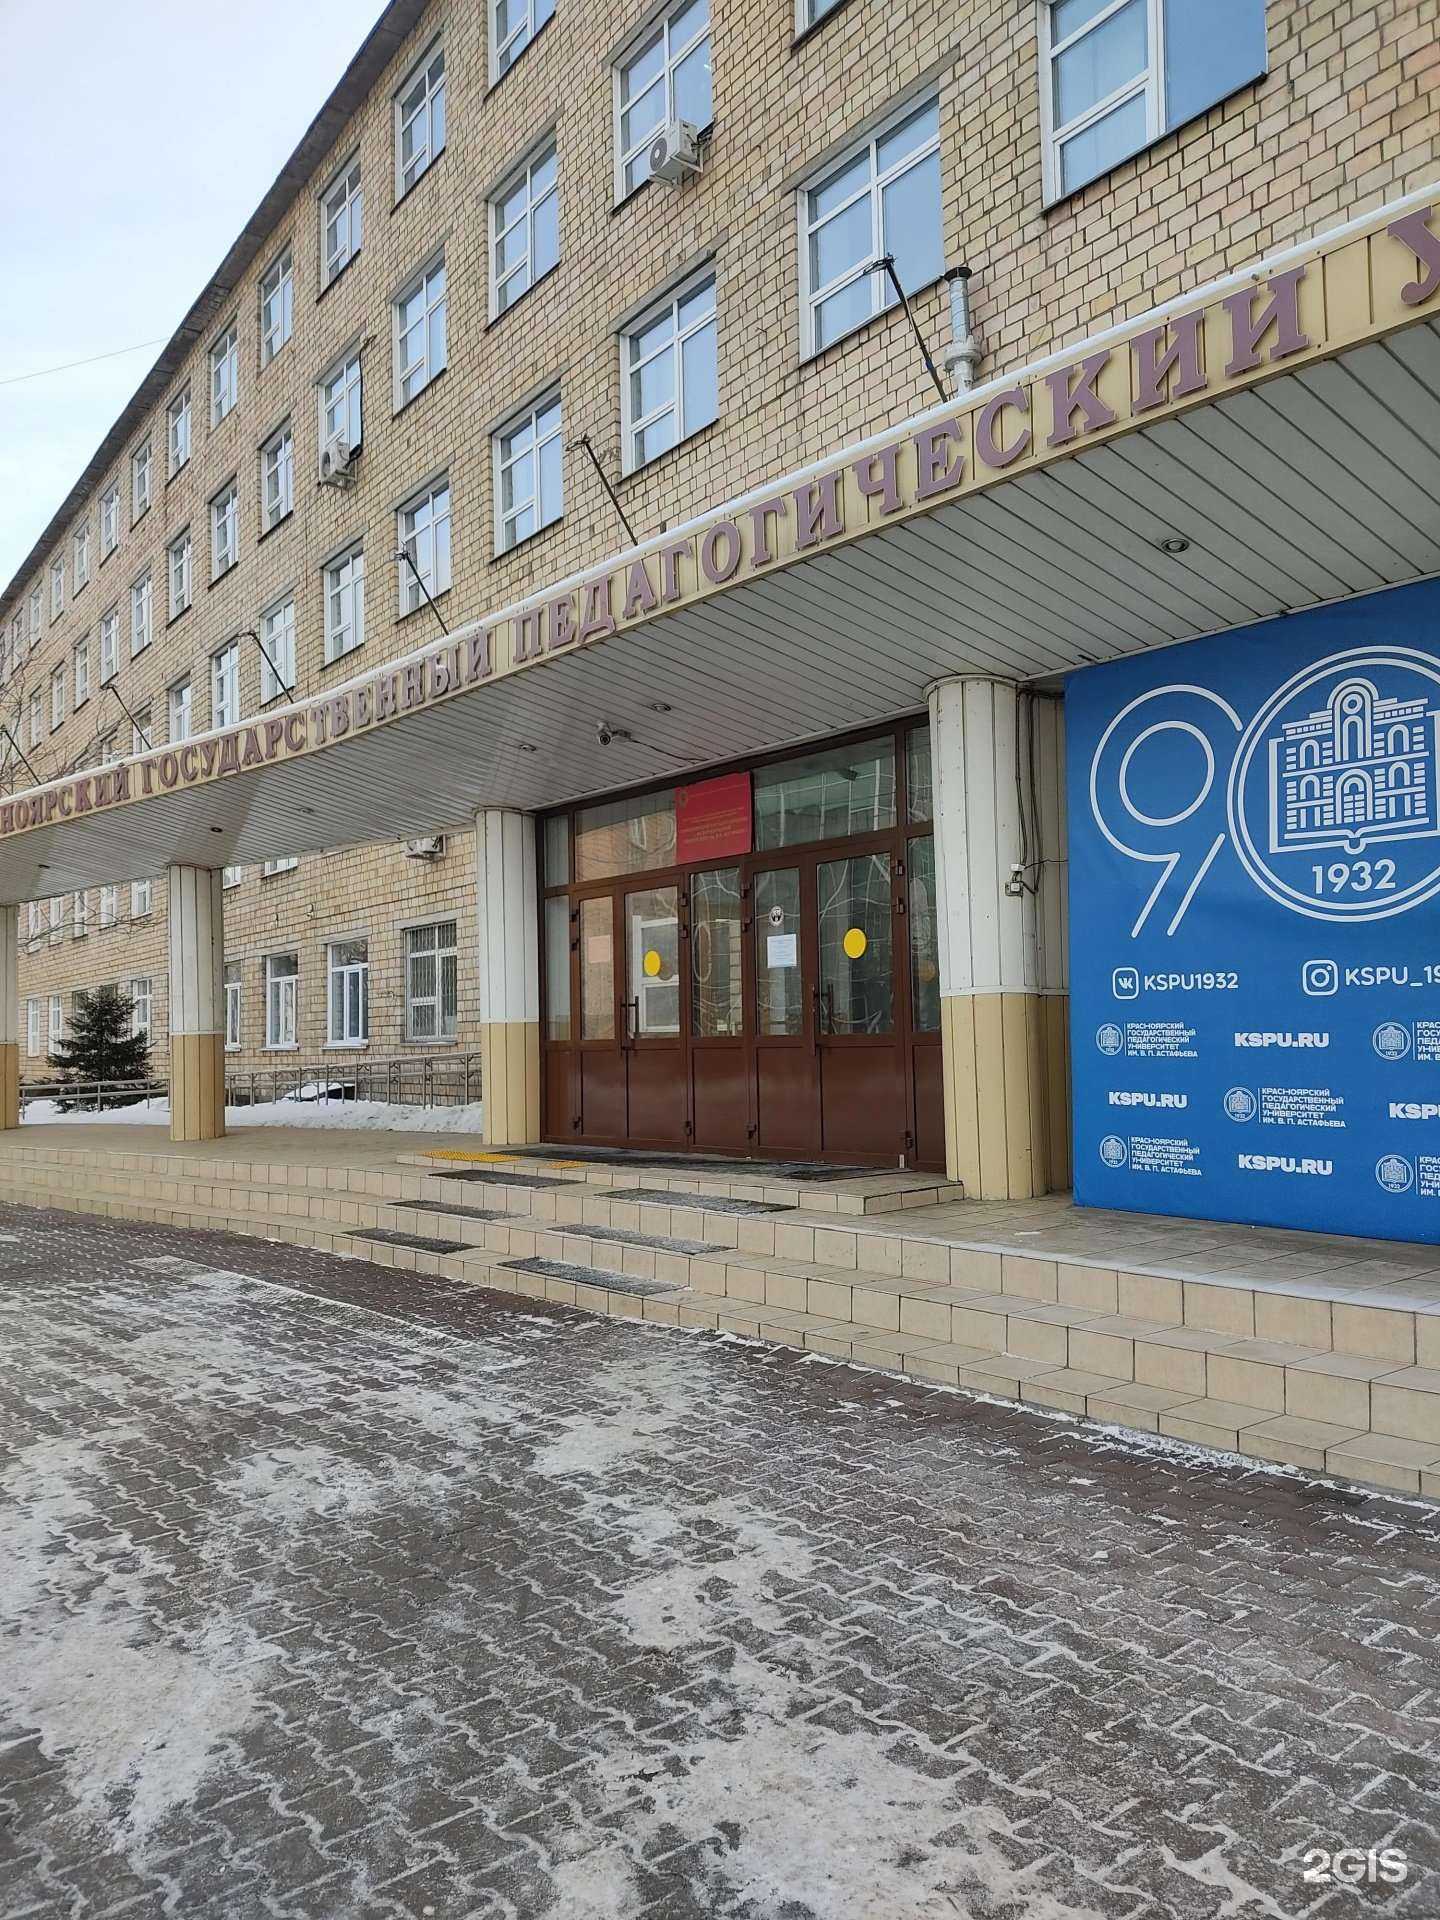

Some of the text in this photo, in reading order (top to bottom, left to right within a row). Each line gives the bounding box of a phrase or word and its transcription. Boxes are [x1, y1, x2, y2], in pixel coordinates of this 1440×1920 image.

[1312, 859, 1396, 894] 1932
[1144, 972, 1239, 991] KSPU1932
[1127, 1022, 1184, 1030] КРАСНОЯРСКИЙ
[1127, 1036, 1190, 1044] ПЕДАГОГИЧЕСКИЙ
[1234, 1032, 1330, 1048] KSPU.RU
[1156, 1050, 1198, 1058] АСТАФЬЕВА
[1262, 1087, 1330, 1097] КРАСНОЯРСКИЙ
[1108, 1091, 1188, 1109] KSPU.RU
[1262, 1095, 1344, 1105] ГОСУДАРСТВЕННЫЙ
[1262, 1102, 1337, 1112] ПЕДАГОГИЧЕСКИЙ
[1388, 1102, 1440, 1120] KSP
[1262, 1110, 1325, 1119] УНИВЕРСИТЕТ
[1297, 1118, 1346, 1128] АСТАФЬЕВА
[1131, 1136, 1188, 1146] КРАСНОЯРСКИЙ
[1132, 1157, 1184, 1167] УНИВЕРСИТЕТ
[1238, 1154, 1333, 1176] KSPU.RU
